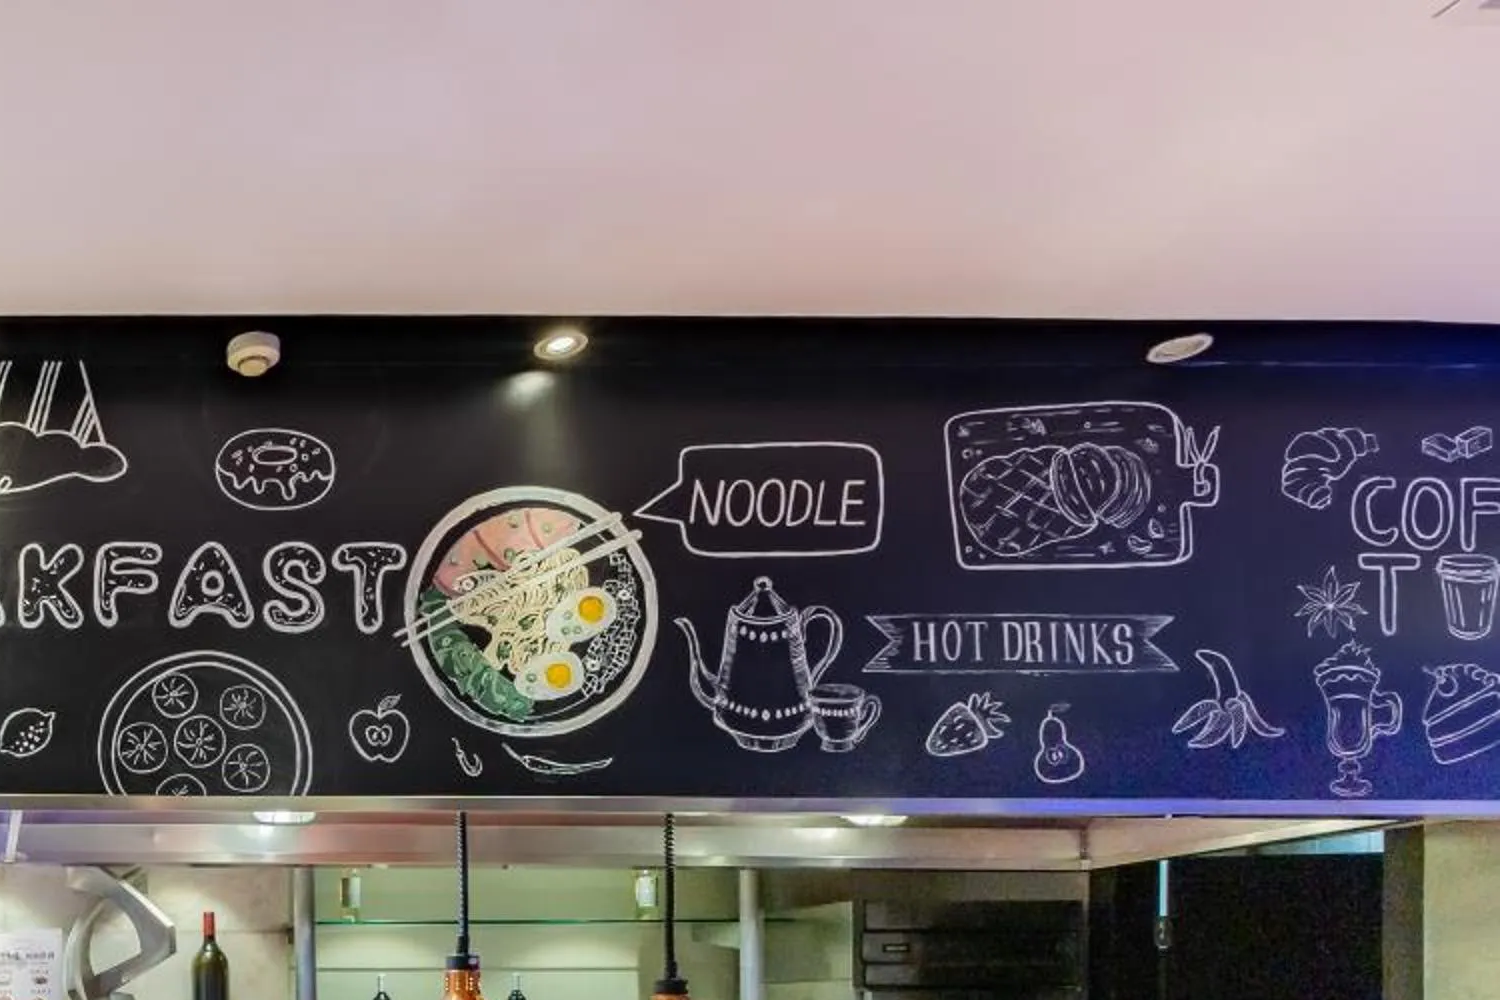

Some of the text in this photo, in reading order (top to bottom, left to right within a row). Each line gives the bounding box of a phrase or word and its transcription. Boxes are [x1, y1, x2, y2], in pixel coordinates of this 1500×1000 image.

[689, 478, 866, 527] NOODLE
[913, 620, 1133, 664] HOT DRINKS
